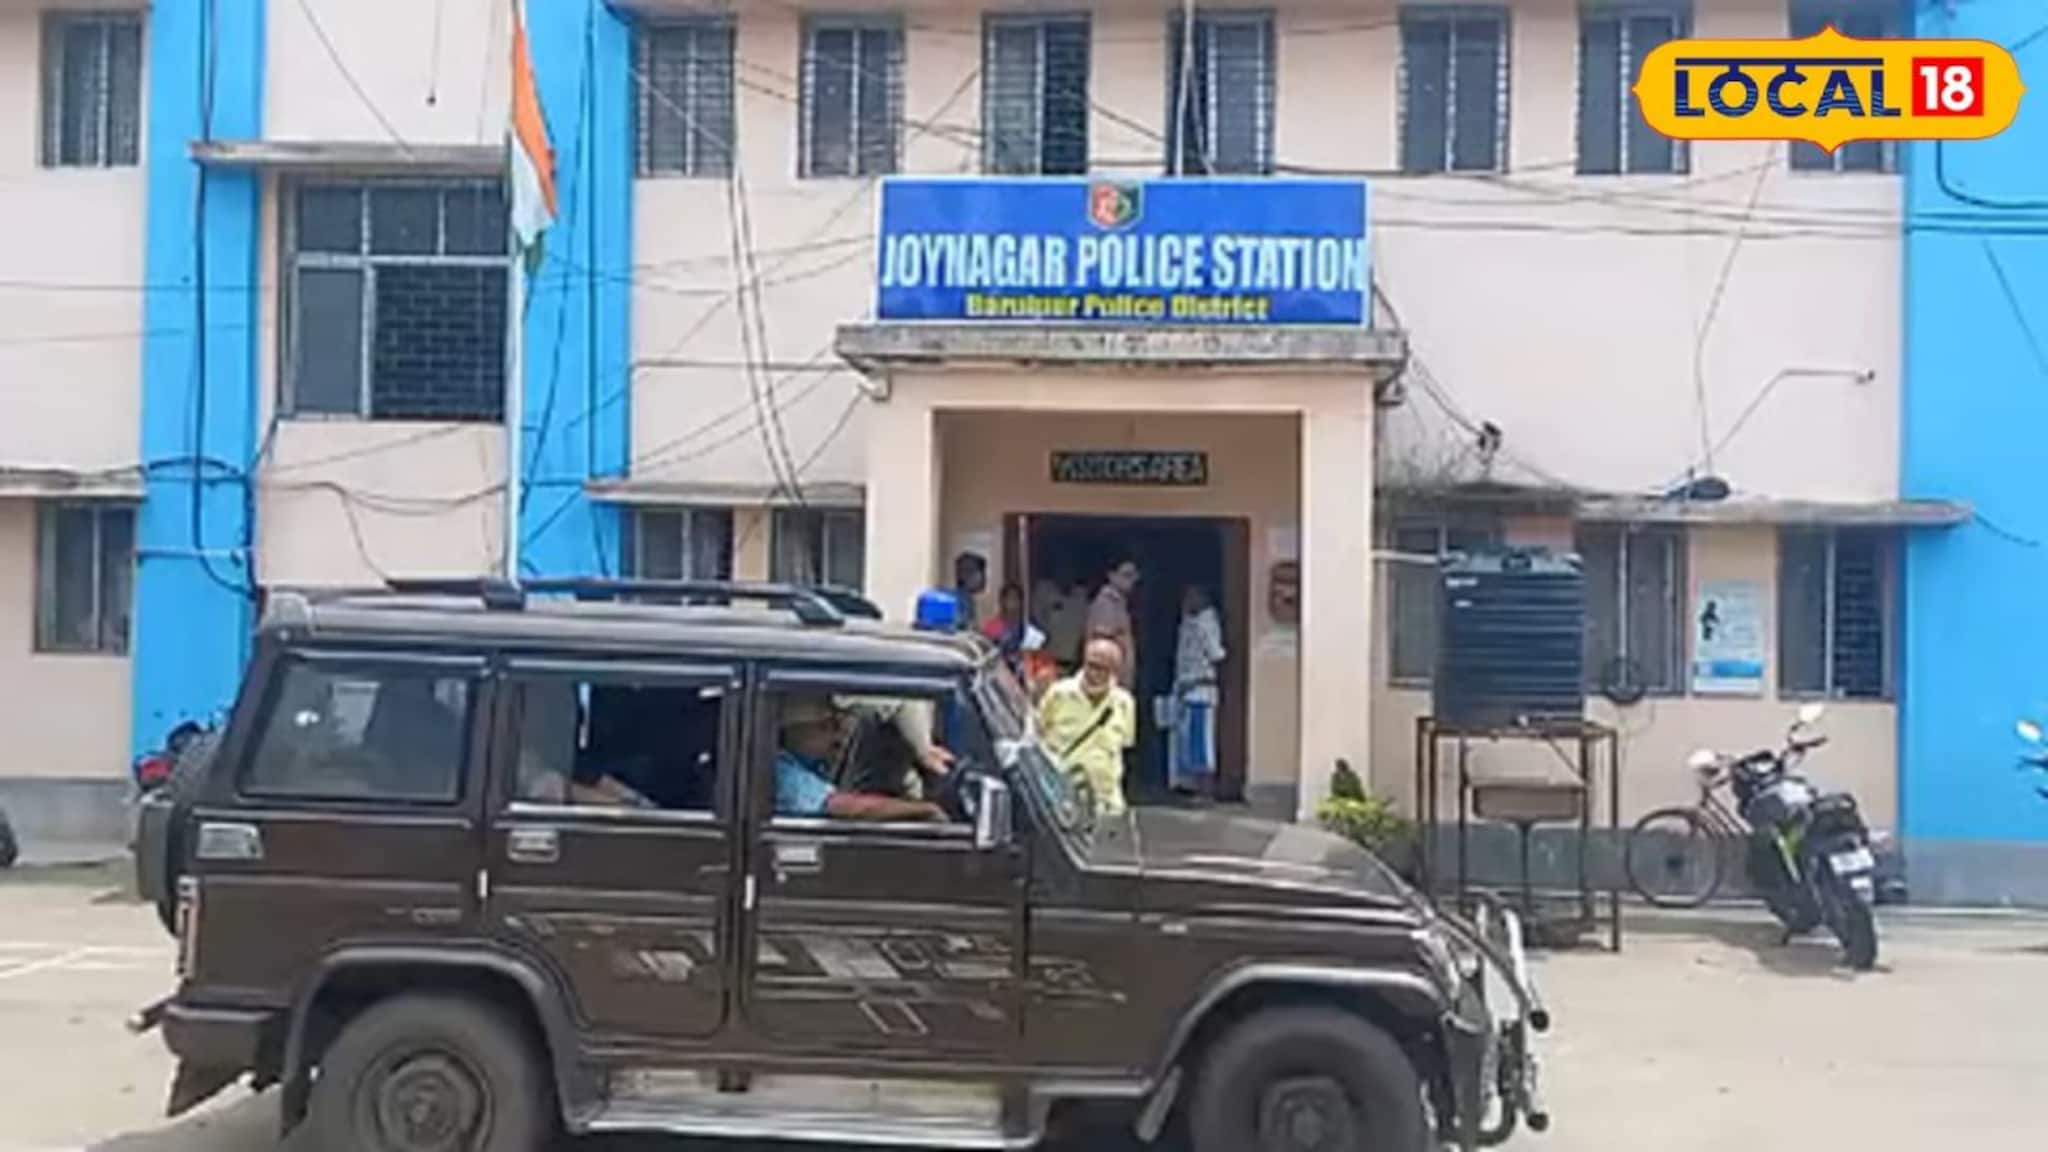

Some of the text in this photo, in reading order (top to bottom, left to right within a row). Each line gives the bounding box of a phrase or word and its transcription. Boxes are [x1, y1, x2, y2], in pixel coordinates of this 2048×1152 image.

[881, 232, 1368, 292] JOYNAGAR POLICE STATION
[1082, 293, 1166, 319] Police
[1170, 294, 1270, 320] District
